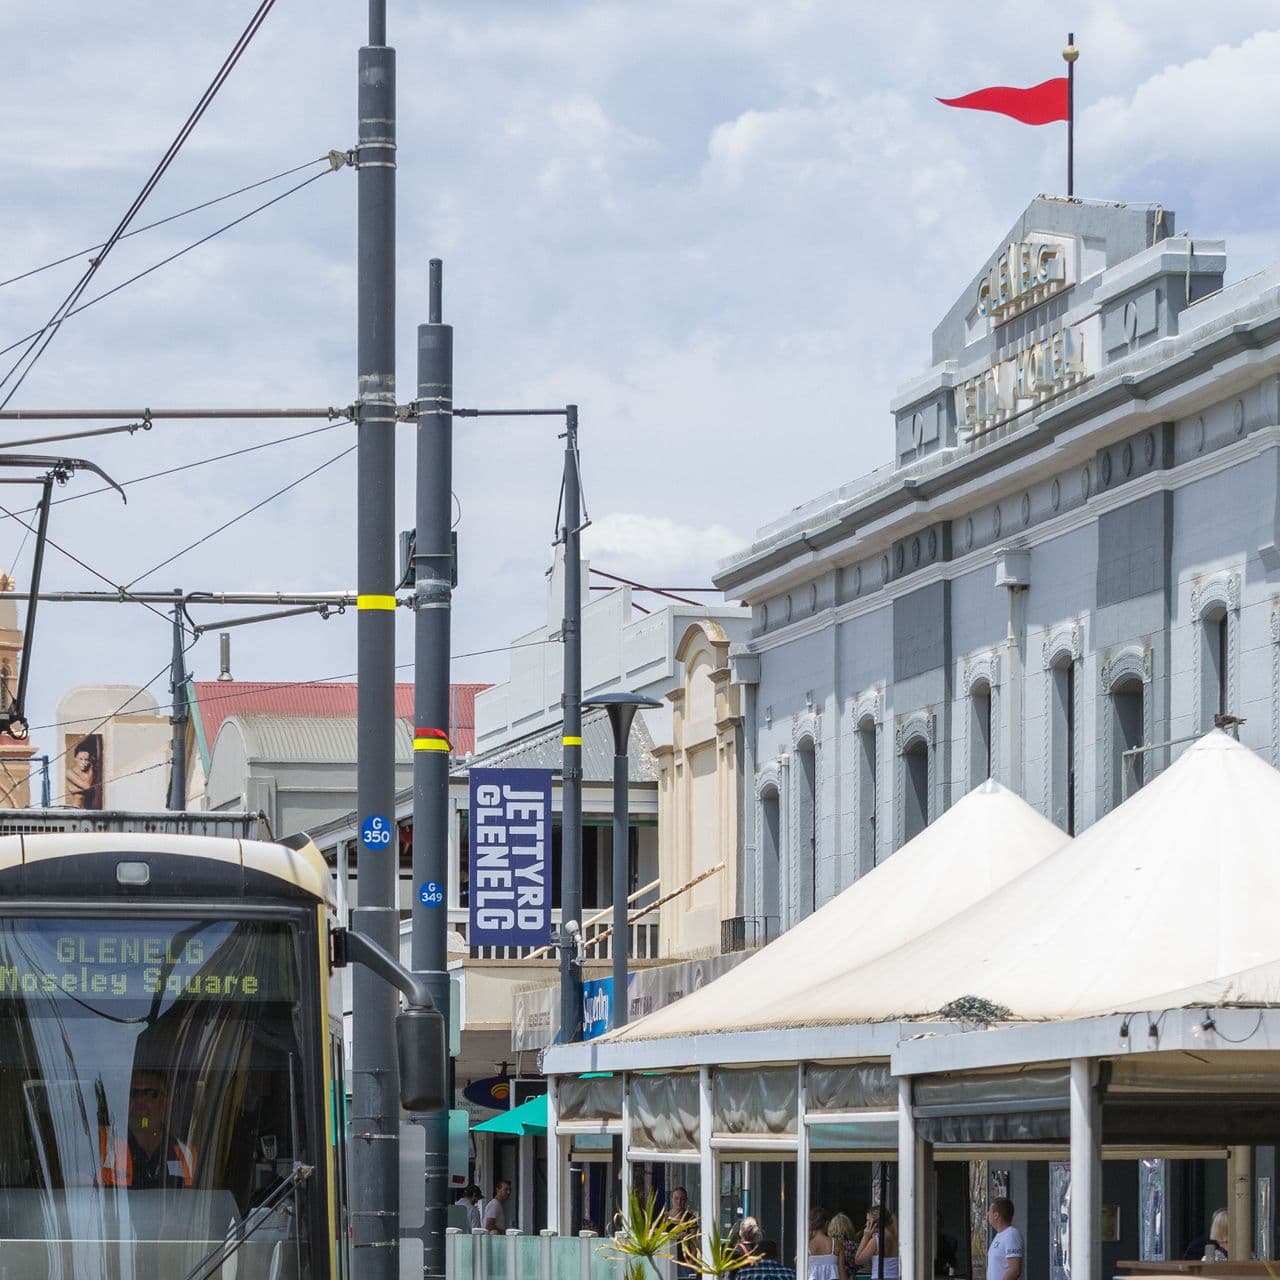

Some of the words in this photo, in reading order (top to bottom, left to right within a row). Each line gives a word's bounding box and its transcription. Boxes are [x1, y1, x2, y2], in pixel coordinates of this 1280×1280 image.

[372, 817, 383, 830] G
[363, 830, 390, 843] 350
[476, 784, 515, 931] GLENELG
[428, 882, 437, 892] G
[421, 892, 443, 903] 349
[56, 936, 204, 964] GLENELG
[0, 965, 128, 995] Moseley
[143, 967, 259, 996] Square
